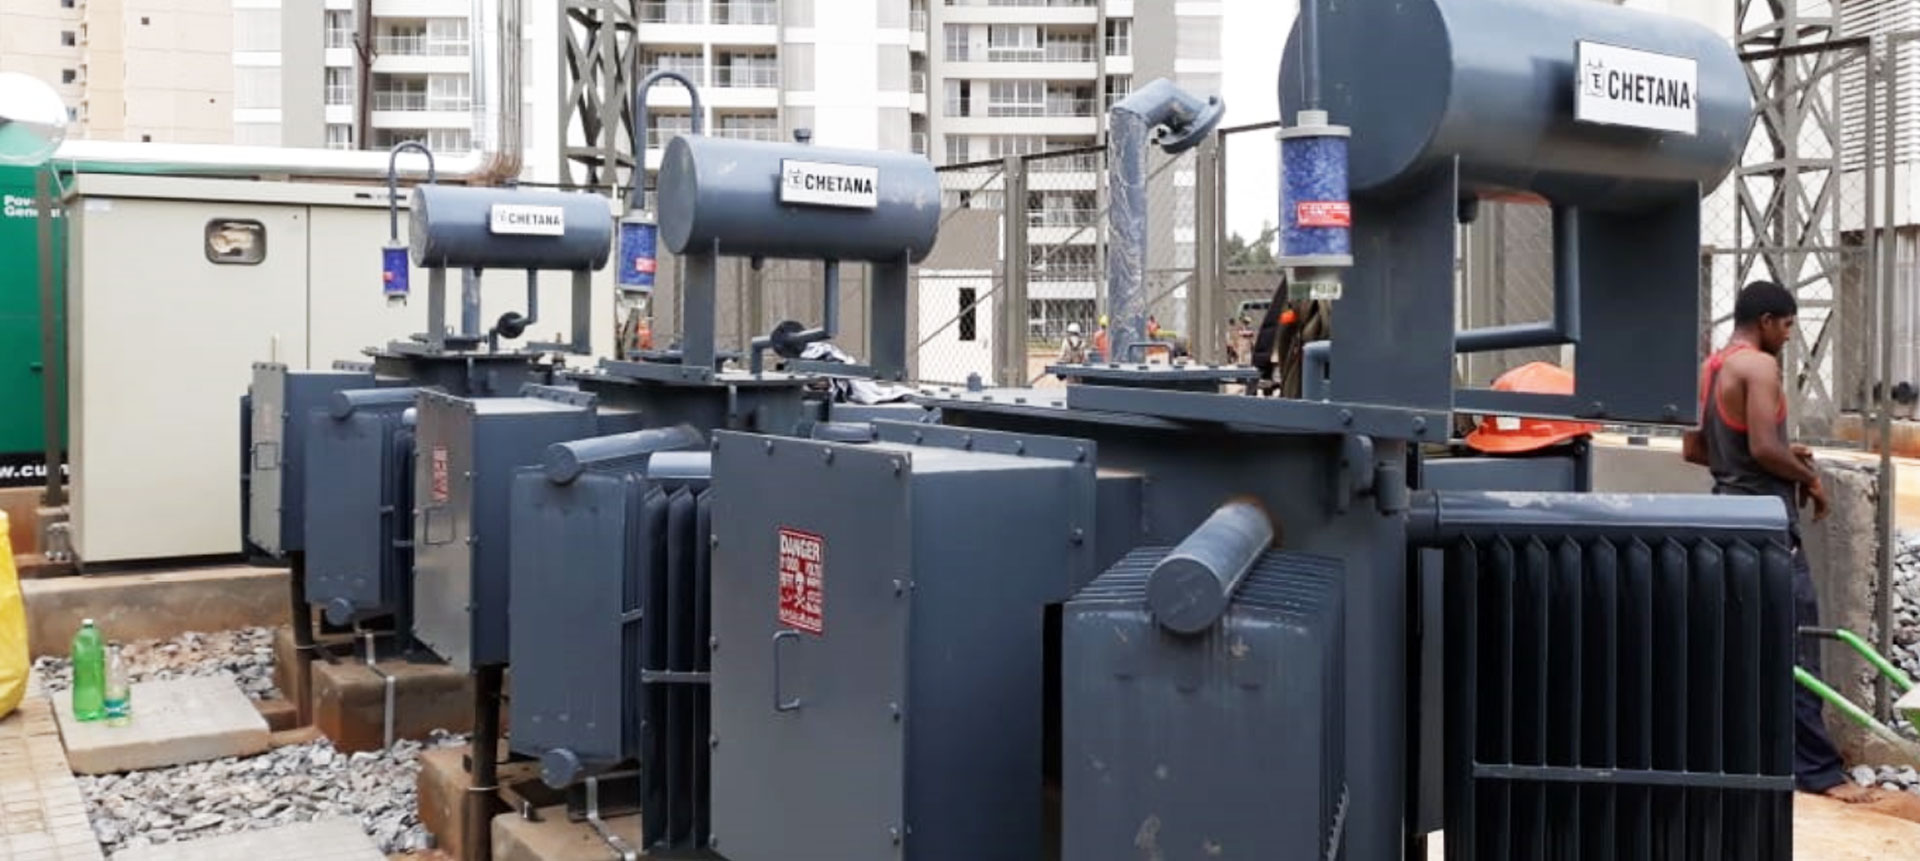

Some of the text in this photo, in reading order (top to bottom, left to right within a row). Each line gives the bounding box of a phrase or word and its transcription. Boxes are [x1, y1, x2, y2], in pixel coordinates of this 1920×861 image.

[1608, 69, 1690, 109] CHETANA
[805, 173, 872, 194] CHETANA
[508, 212, 561, 226] CHETANA
[780, 534, 820, 562] DANGER
